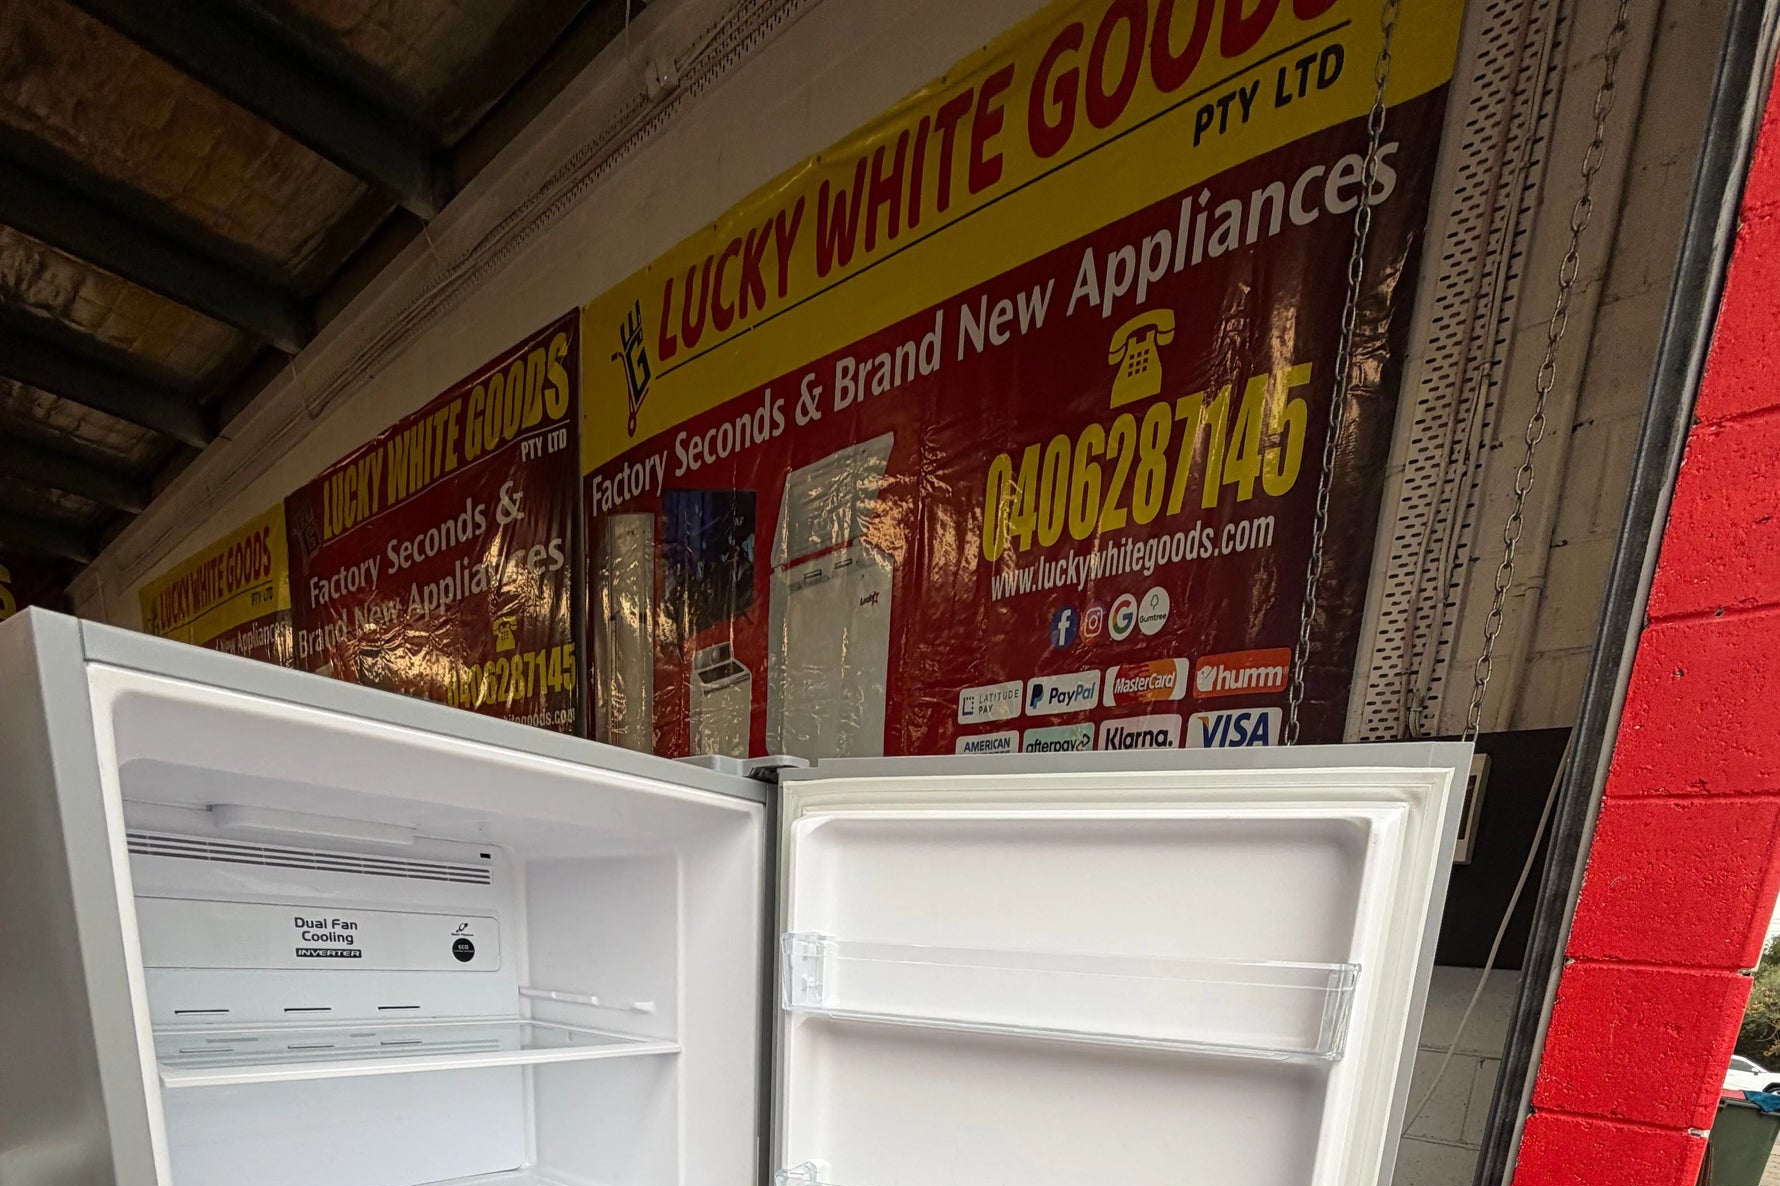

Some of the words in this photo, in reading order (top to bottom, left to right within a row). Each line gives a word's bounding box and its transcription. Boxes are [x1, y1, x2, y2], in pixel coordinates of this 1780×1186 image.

[1192, 79, 1260, 147] PTY
[1274, 43, 1345, 109] LTD
[658, 195, 805, 362] LUCKY
[815, 62, 1015, 278] WHITE
[591, 449, 669, 518] Factory
[675, 387, 785, 478] Seconds
[795, 373, 822, 427] &
[834, 309, 943, 413] Brand
[957, 278, 1056, 361] New
[1065, 141, 1399, 318] Appliances
[322, 447, 384, 541] LUCKY
[387, 397, 463, 506] WHITE
[464, 331, 570, 461] GOODS
[520, 436, 543, 463] PTY
[547, 427, 568, 455] LTD
[982, 361, 1313, 562] 0406287145
[310, 554, 381, 609] Factory
[386, 497, 487, 576] Seconds
[495, 480, 525, 525] &
[990, 514, 1276, 602] www.luckywhitegoods.com
[160, 573, 191, 631] LUCKY
[190, 553, 225, 614] WHITE
[226, 524, 272, 595] GOODS
[1139, 610, 1168, 624] Gumtree
[299, 608, 348, 659] Brand
[1048, 680, 1097, 706] PayPal
[1113, 670, 1177, 695] MasterCard
[1217, 664, 1283, 692] humm
[979, 688, 1020, 705] LATITUDE
[979, 703, 994, 714] PAY
[963, 737, 1011, 753] AMERICAN
[1026, 738, 1076, 753] afterpay
[1199, 712, 1269, 748] VISA
[294, 916, 328, 930] Dual
[331, 918, 358, 931] Fan
[301, 930, 354, 945] Cooling
[297, 948, 361, 958] INVERTER
